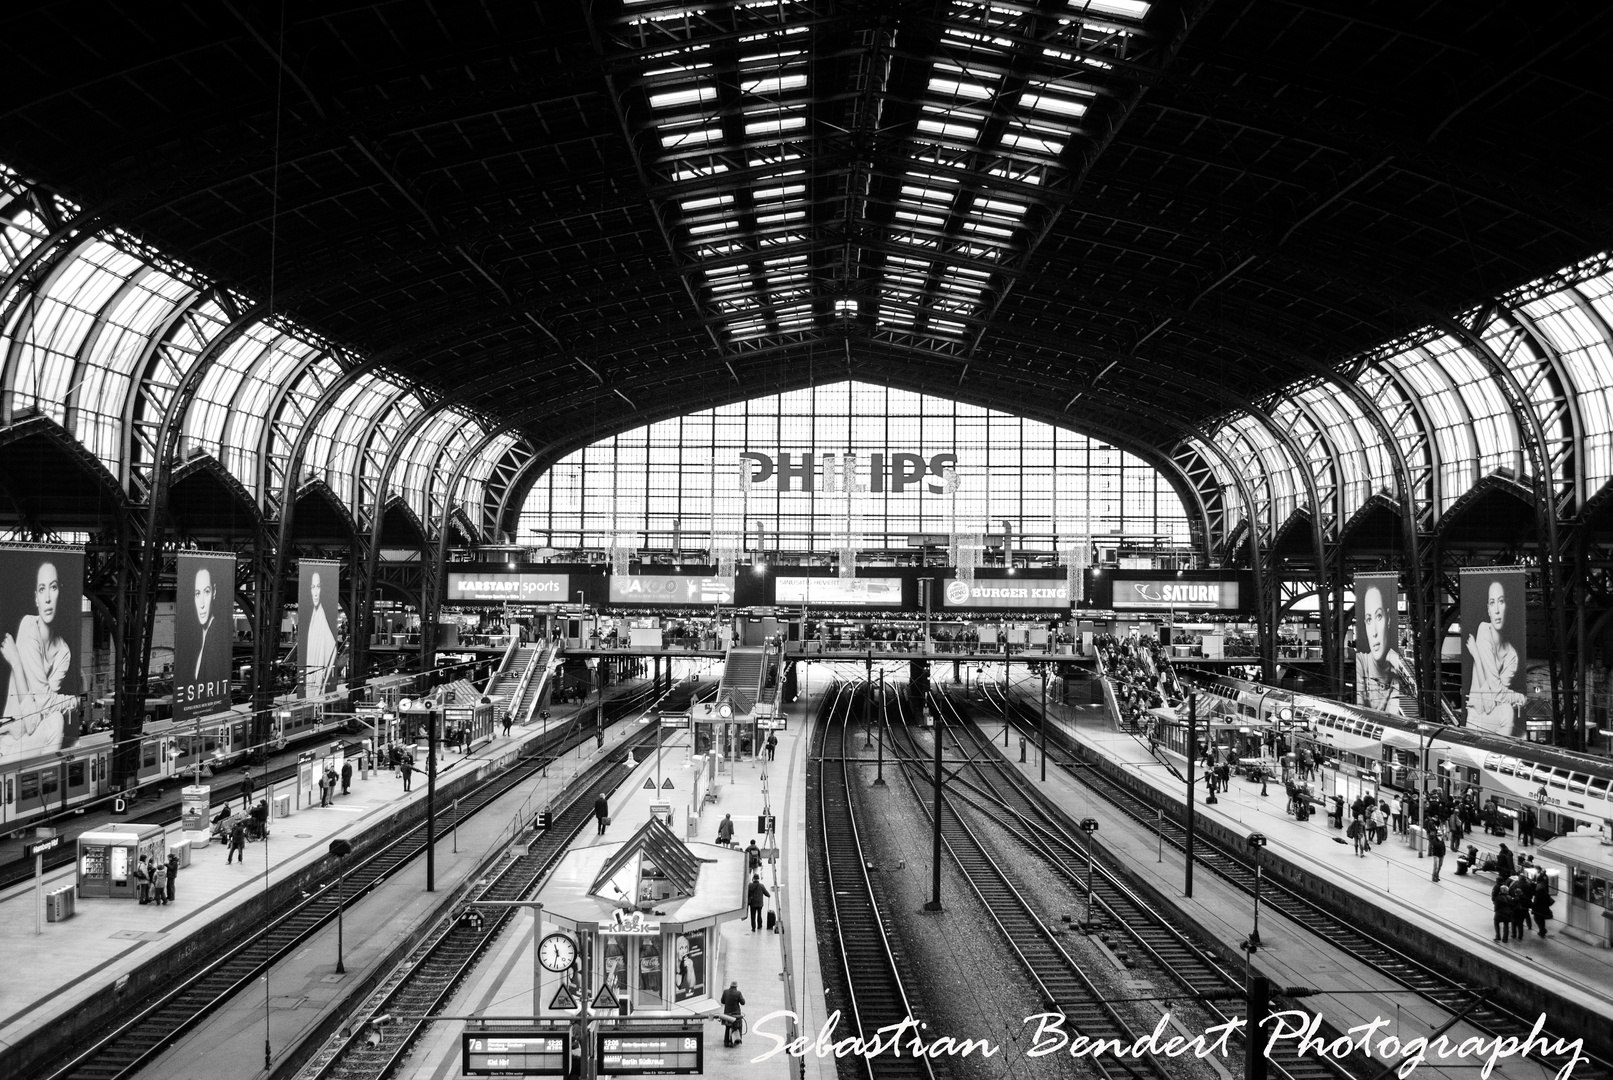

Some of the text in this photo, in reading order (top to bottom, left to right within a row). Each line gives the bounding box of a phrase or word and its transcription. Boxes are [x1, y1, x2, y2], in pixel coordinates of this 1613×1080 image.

[739, 452, 962, 494] PHILIPS
[457, 580, 560, 594] KARSTADT sports
[972, 588, 1028, 599] BURGER
[1031, 588, 1067, 599] KING
[1162, 584, 1220, 602] SATURN
[177, 679, 229, 703] ESPRIT
[115, 798, 126, 812] D
[536, 813, 546, 826] E
[608, 923, 650, 933] KIOSK
[469, 1038, 482, 1051] 7a
[684, 1038, 697, 1049] 8a
